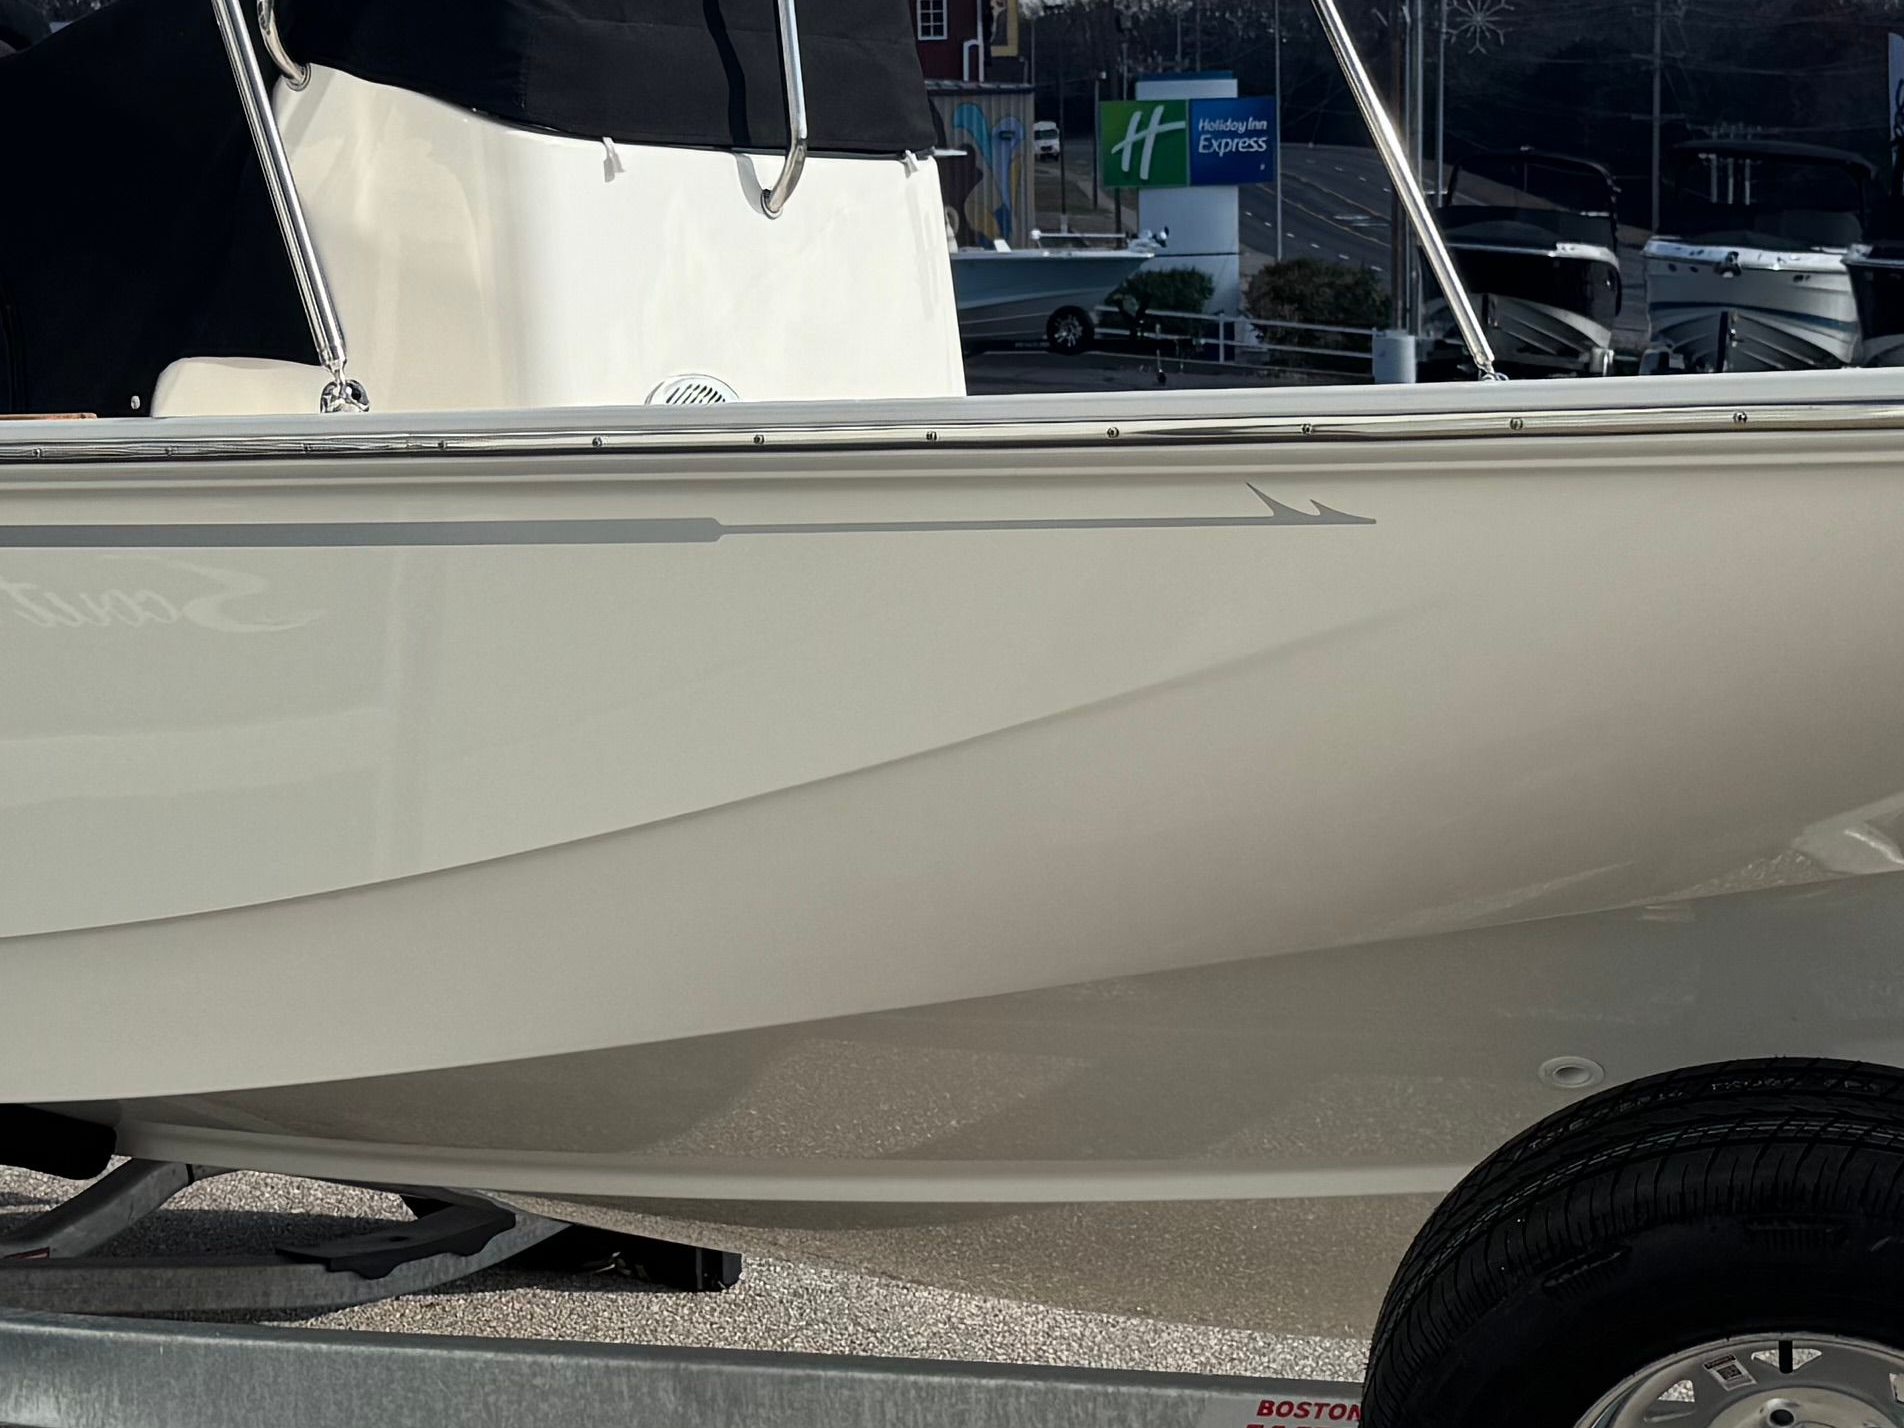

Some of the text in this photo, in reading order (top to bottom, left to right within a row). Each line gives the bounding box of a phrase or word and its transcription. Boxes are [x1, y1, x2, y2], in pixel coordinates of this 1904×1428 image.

[1198, 117, 1267, 134] Holiday Inn
[1198, 134, 1267, 157] Express
[1257, 1399, 1361, 1422] BOSTON
